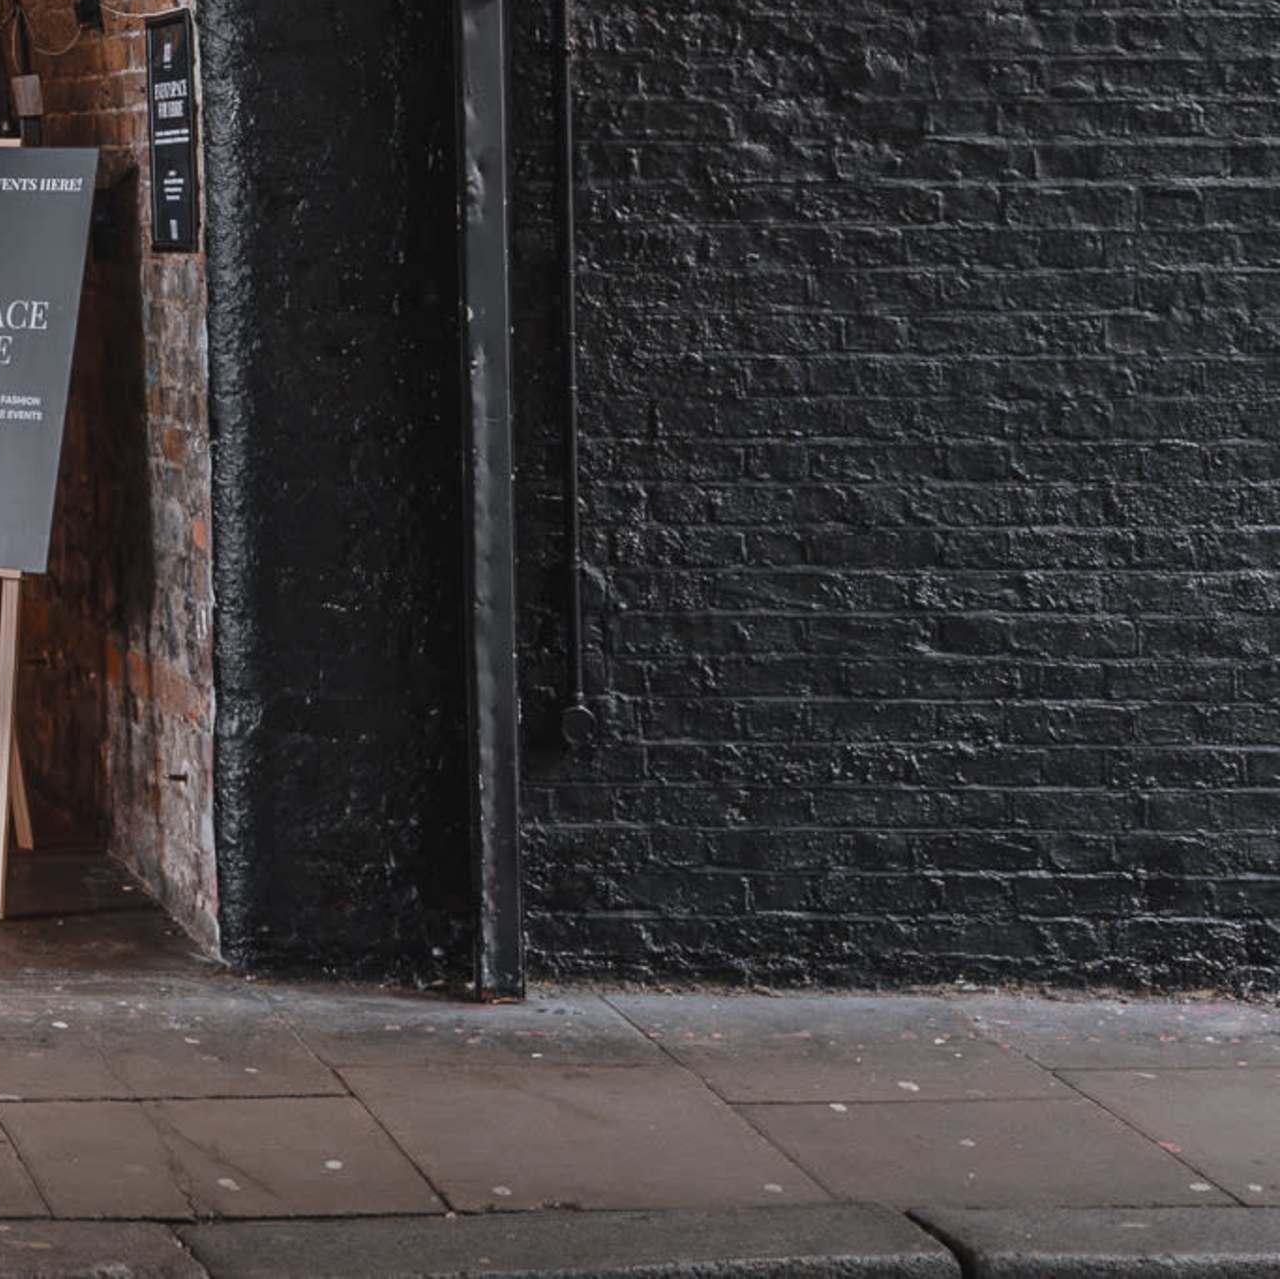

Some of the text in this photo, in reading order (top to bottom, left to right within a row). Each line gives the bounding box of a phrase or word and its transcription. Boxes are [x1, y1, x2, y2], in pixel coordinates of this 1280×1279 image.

[40, 178, 83, 192] HERE!
[0, 395, 41, 406] FASHION
[7, 410, 43, 421] EVENTS
